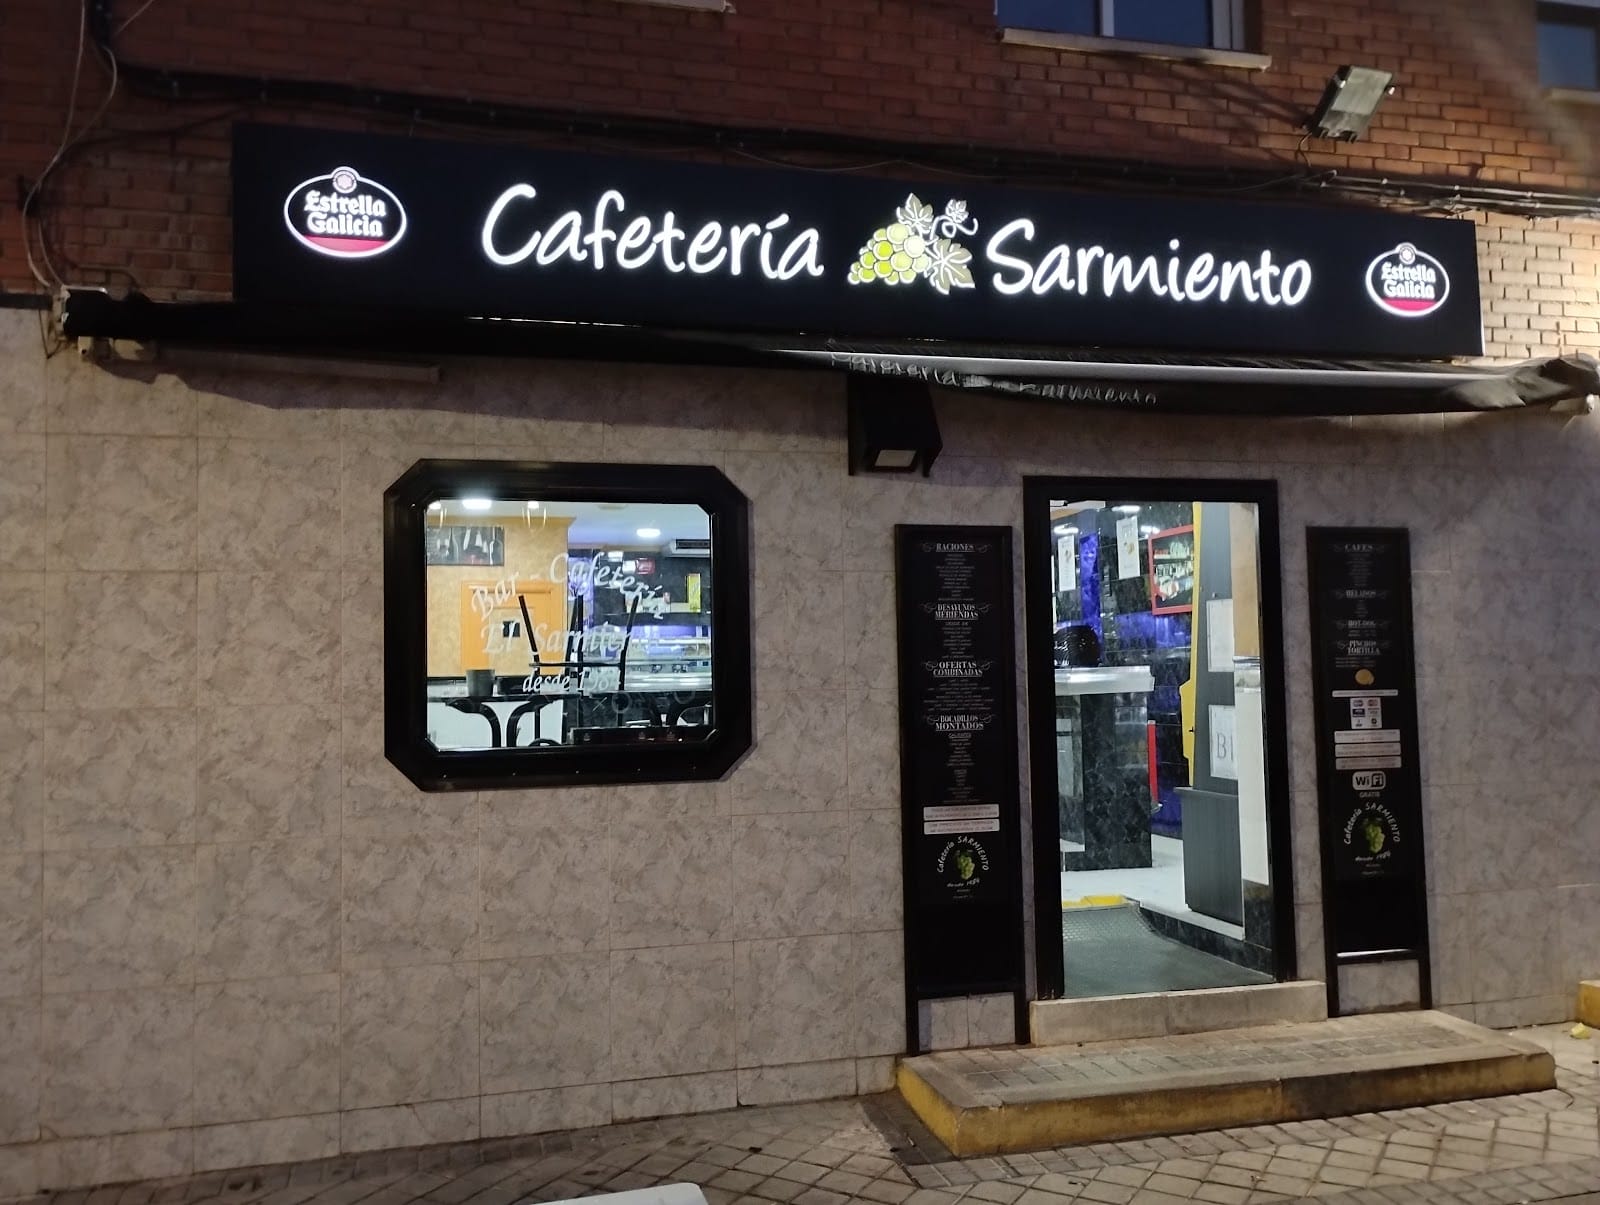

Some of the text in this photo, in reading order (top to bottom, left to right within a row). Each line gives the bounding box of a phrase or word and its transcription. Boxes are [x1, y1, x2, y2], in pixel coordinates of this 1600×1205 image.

[304, 189, 386, 216] Estrella
[306, 212, 383, 237] Galicia
[481, 182, 1312, 306] Cafetería Sarmiento
[1381, 261, 1436, 283] Estrella
[1383, 280, 1435, 299] Galicia
[936, 543, 975, 552] RACIONES
[470, 571, 519, 620] Bar
[935, 611, 979, 619] MERIENDAS
[937, 604, 976, 612] DESAYUNOS
[481, 620, 517, 654] El
[932, 668, 984, 677] COMBINADAS
[938, 661, 977, 669] OFERTAS
[522, 669, 570, 693] desde
[935, 722, 985, 731] MONTADOS
[940, 715, 980, 723] BOCADILLOS
[1365, 802, 1401, 843] SARMIENTO
[957, 835, 989, 872] SARMIENTO
